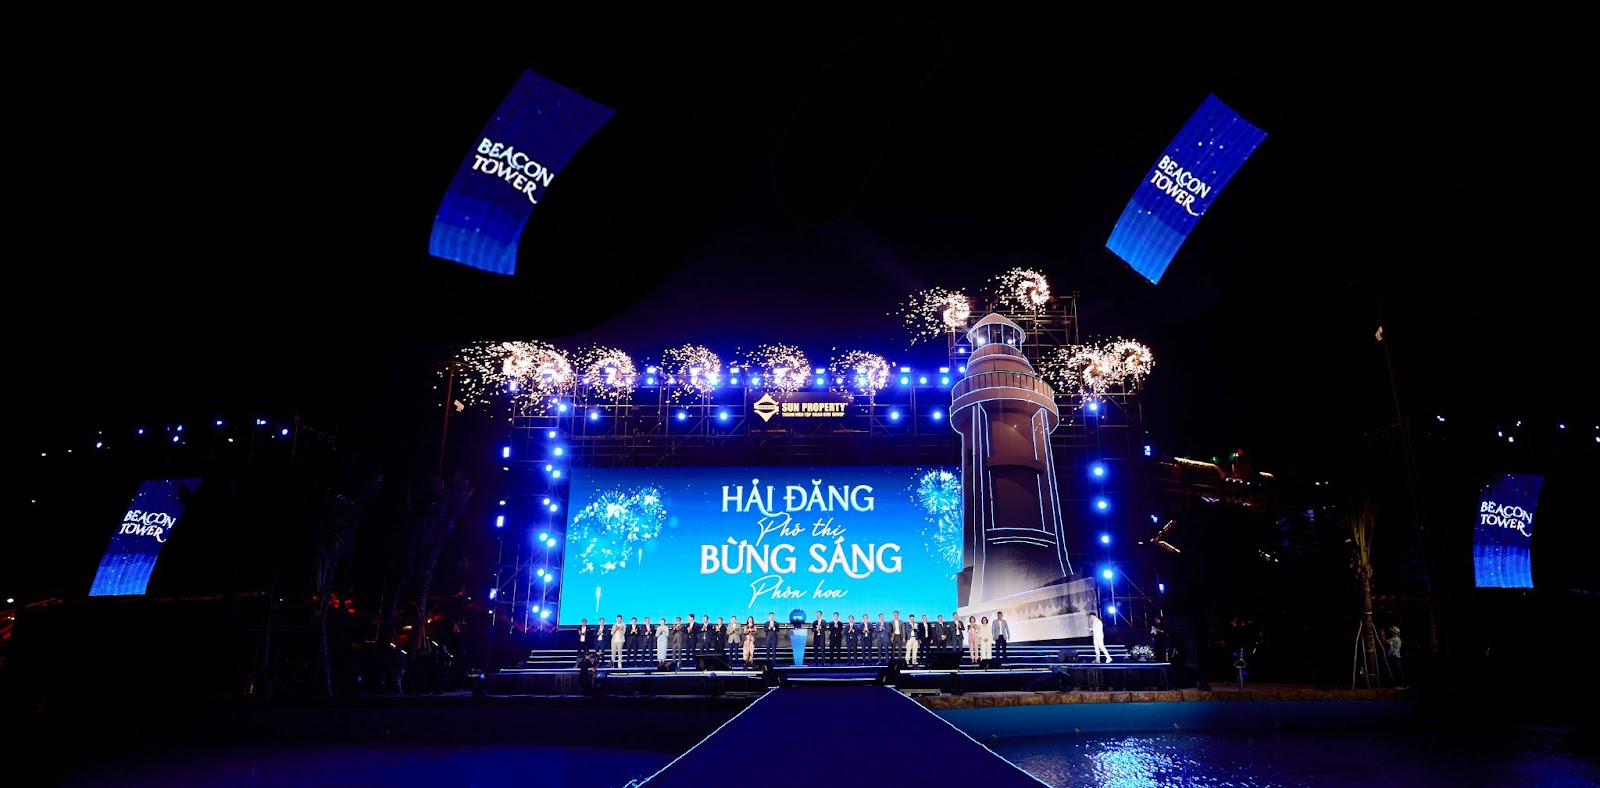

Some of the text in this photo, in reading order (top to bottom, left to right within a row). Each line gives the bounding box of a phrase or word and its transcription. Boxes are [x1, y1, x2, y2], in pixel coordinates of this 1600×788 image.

[477, 137, 555, 187] BEACON
[1157, 155, 1212, 199] BEACON
[472, 154, 538, 204] TOWER
[1150, 170, 1200, 216] TOWER
[781, 402, 846, 412] SUN PROPERTY
[722, 478, 875, 517] HẢI ĐĂNG
[1480, 501, 1533, 524] BEACON
[118, 522, 167, 543] TOWER
[123, 509, 177, 528] BEACON
[1480, 513, 1532, 537] TOWER
[700, 536, 903, 579] BỪNG SÁNG
[812, 579, 849, 599] hoa
